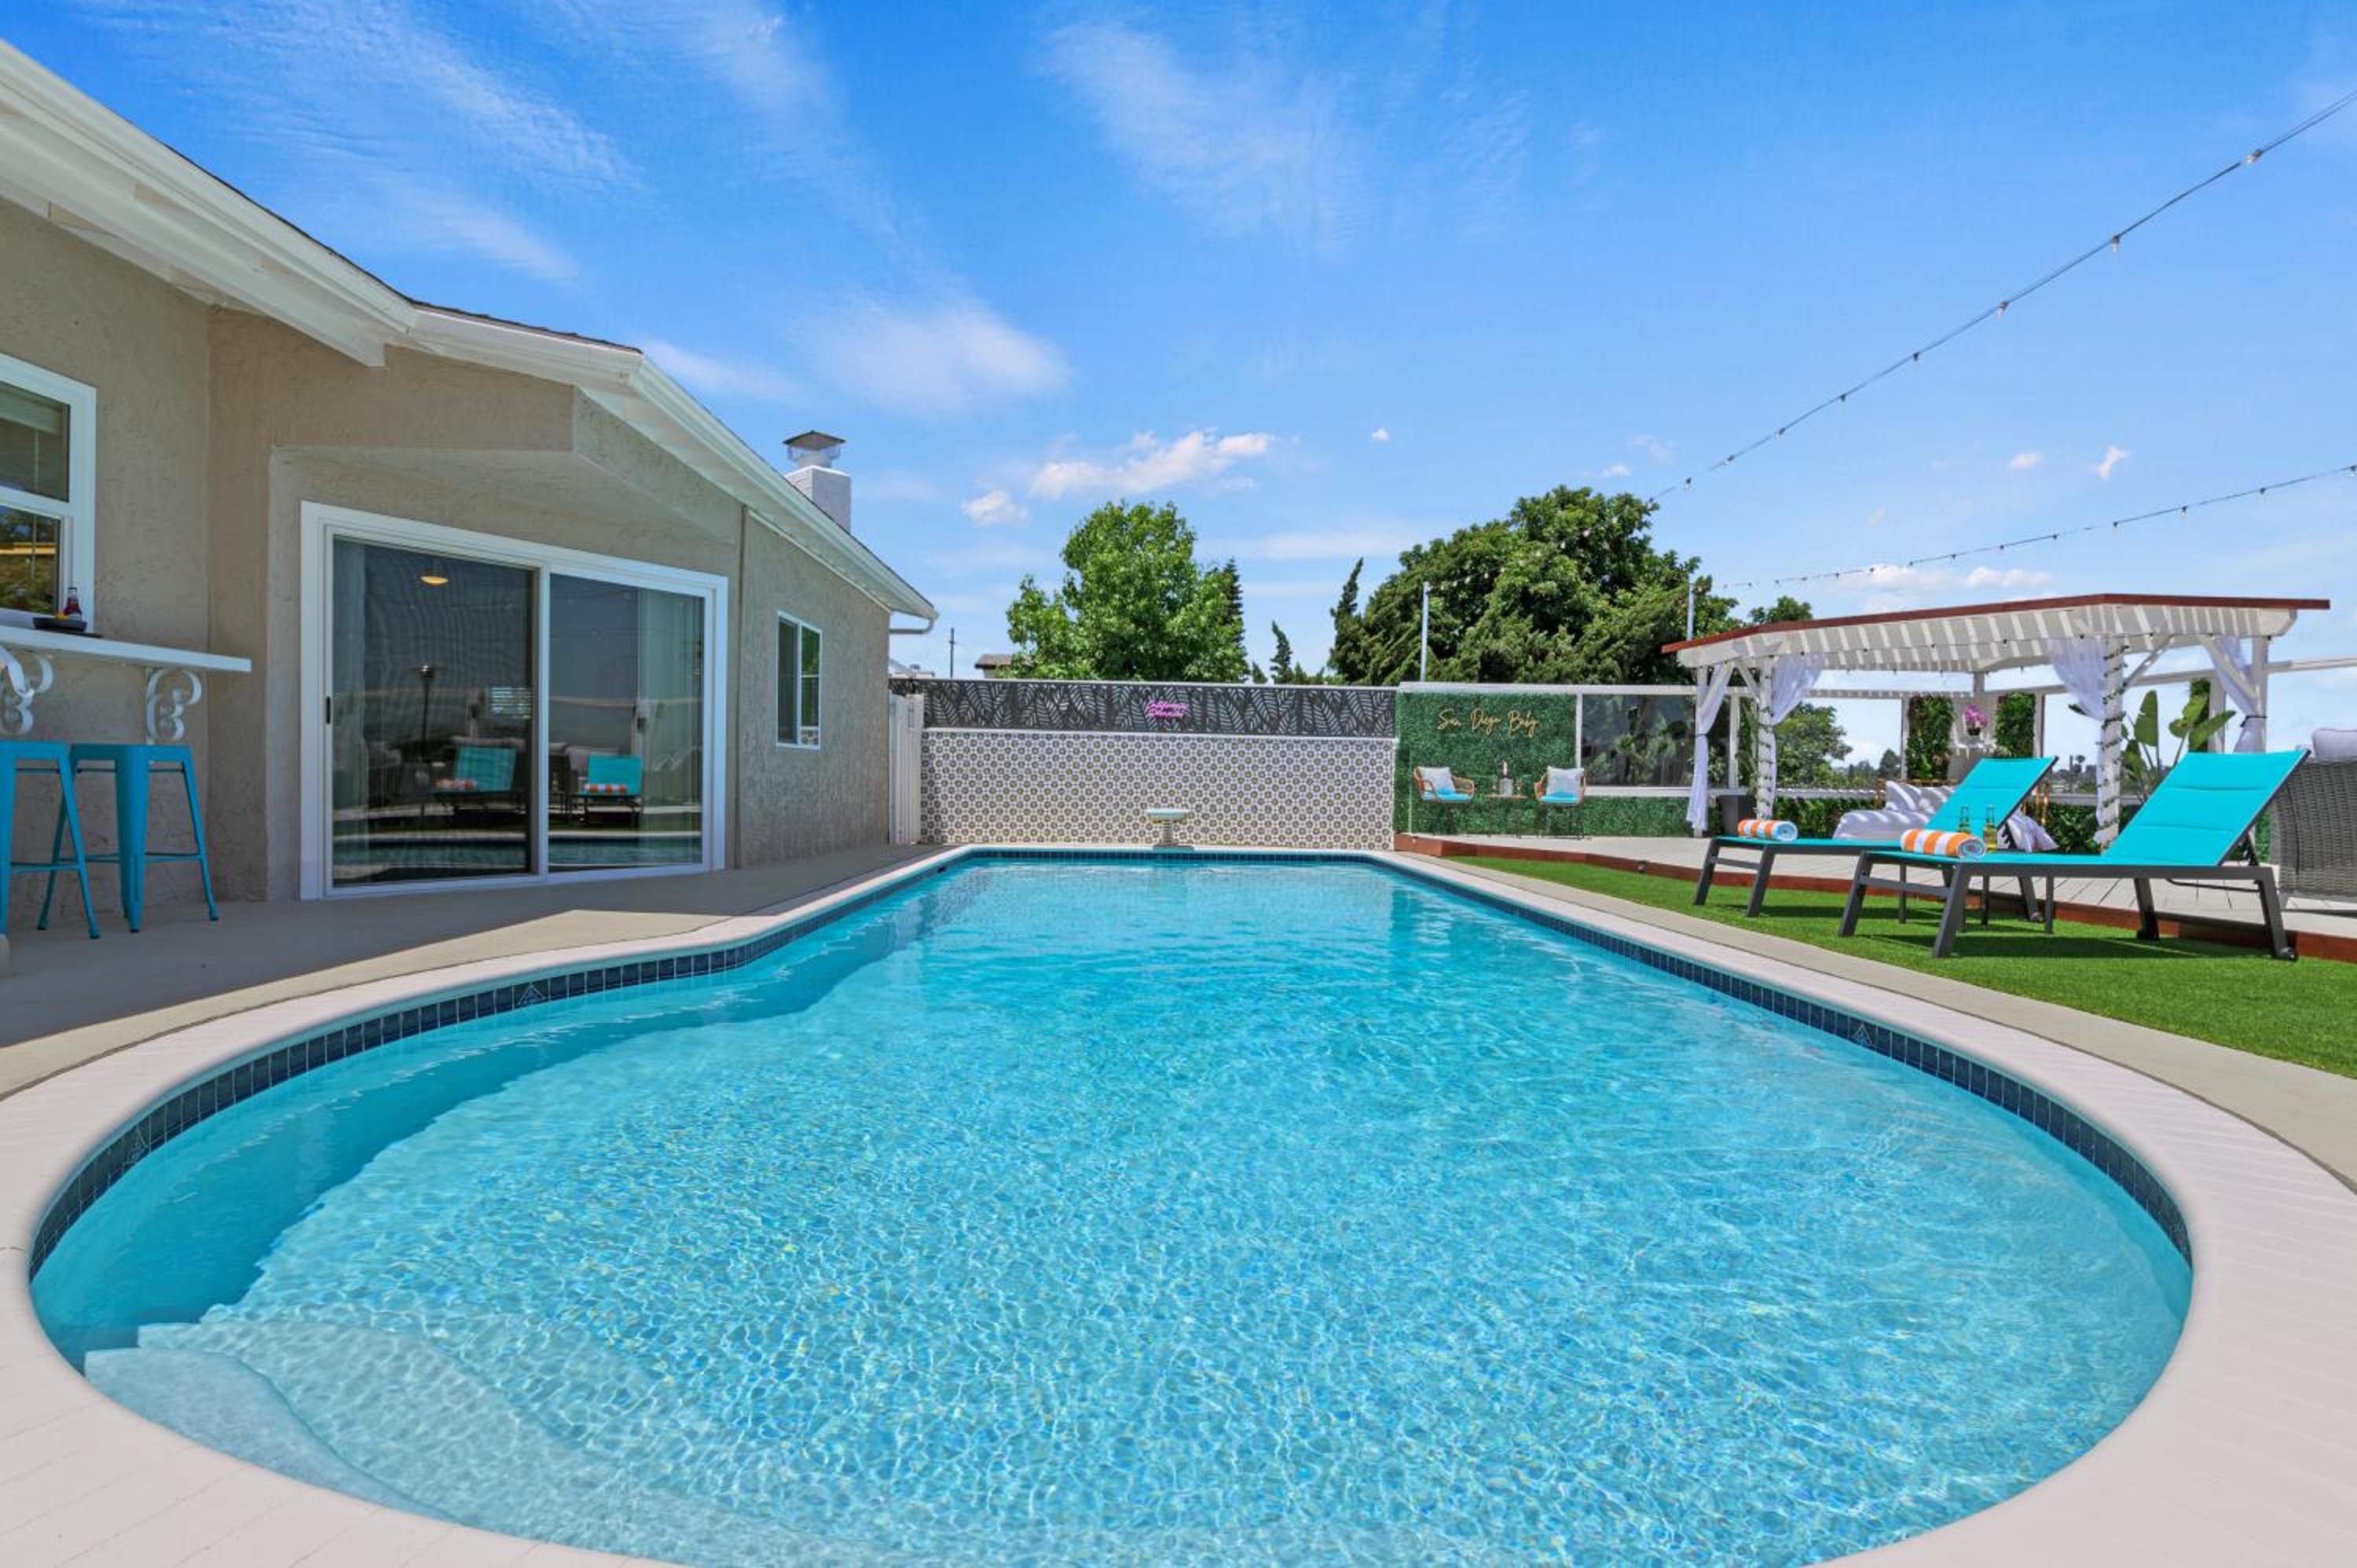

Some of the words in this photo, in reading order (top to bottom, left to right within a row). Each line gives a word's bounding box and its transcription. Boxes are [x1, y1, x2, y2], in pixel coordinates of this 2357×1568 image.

[1437, 708, 1461, 730] San
[1471, 708, 1501, 736] Diego
[1508, 709, 1539, 738] Baby
